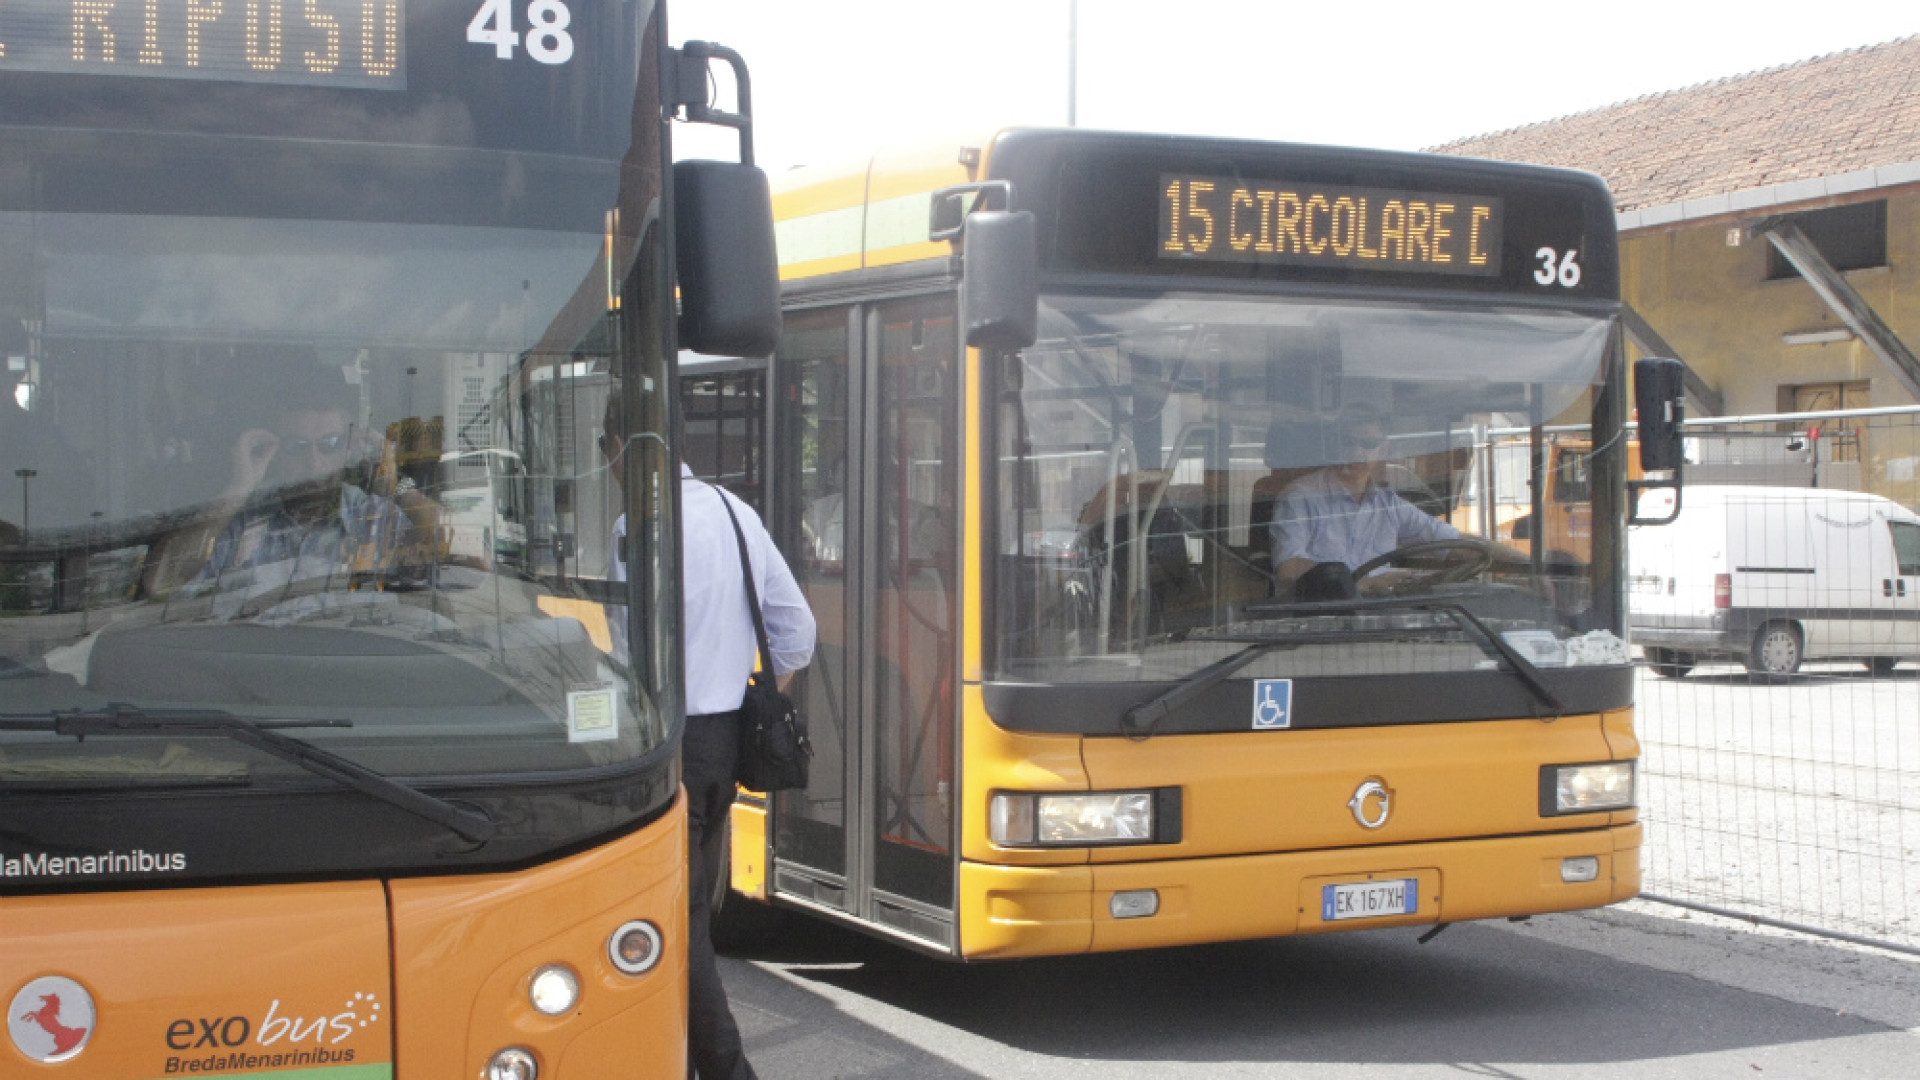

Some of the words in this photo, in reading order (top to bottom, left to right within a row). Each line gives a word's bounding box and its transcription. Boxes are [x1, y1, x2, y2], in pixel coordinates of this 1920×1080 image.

[466, 0, 574, 65] 48
[1164, 180, 1215, 252] 15
[1230, 189, 1455, 263] CIRCOLARE
[1533, 246, 1581, 288] 36
[0, 849, 187, 877] aMenarinibus
[1336, 891, 1354, 913] EK
[166, 1016, 250, 1050] exo
[257, 999, 356, 1046] bus
[164, 1048, 356, 1073] BredaMenarinibus
